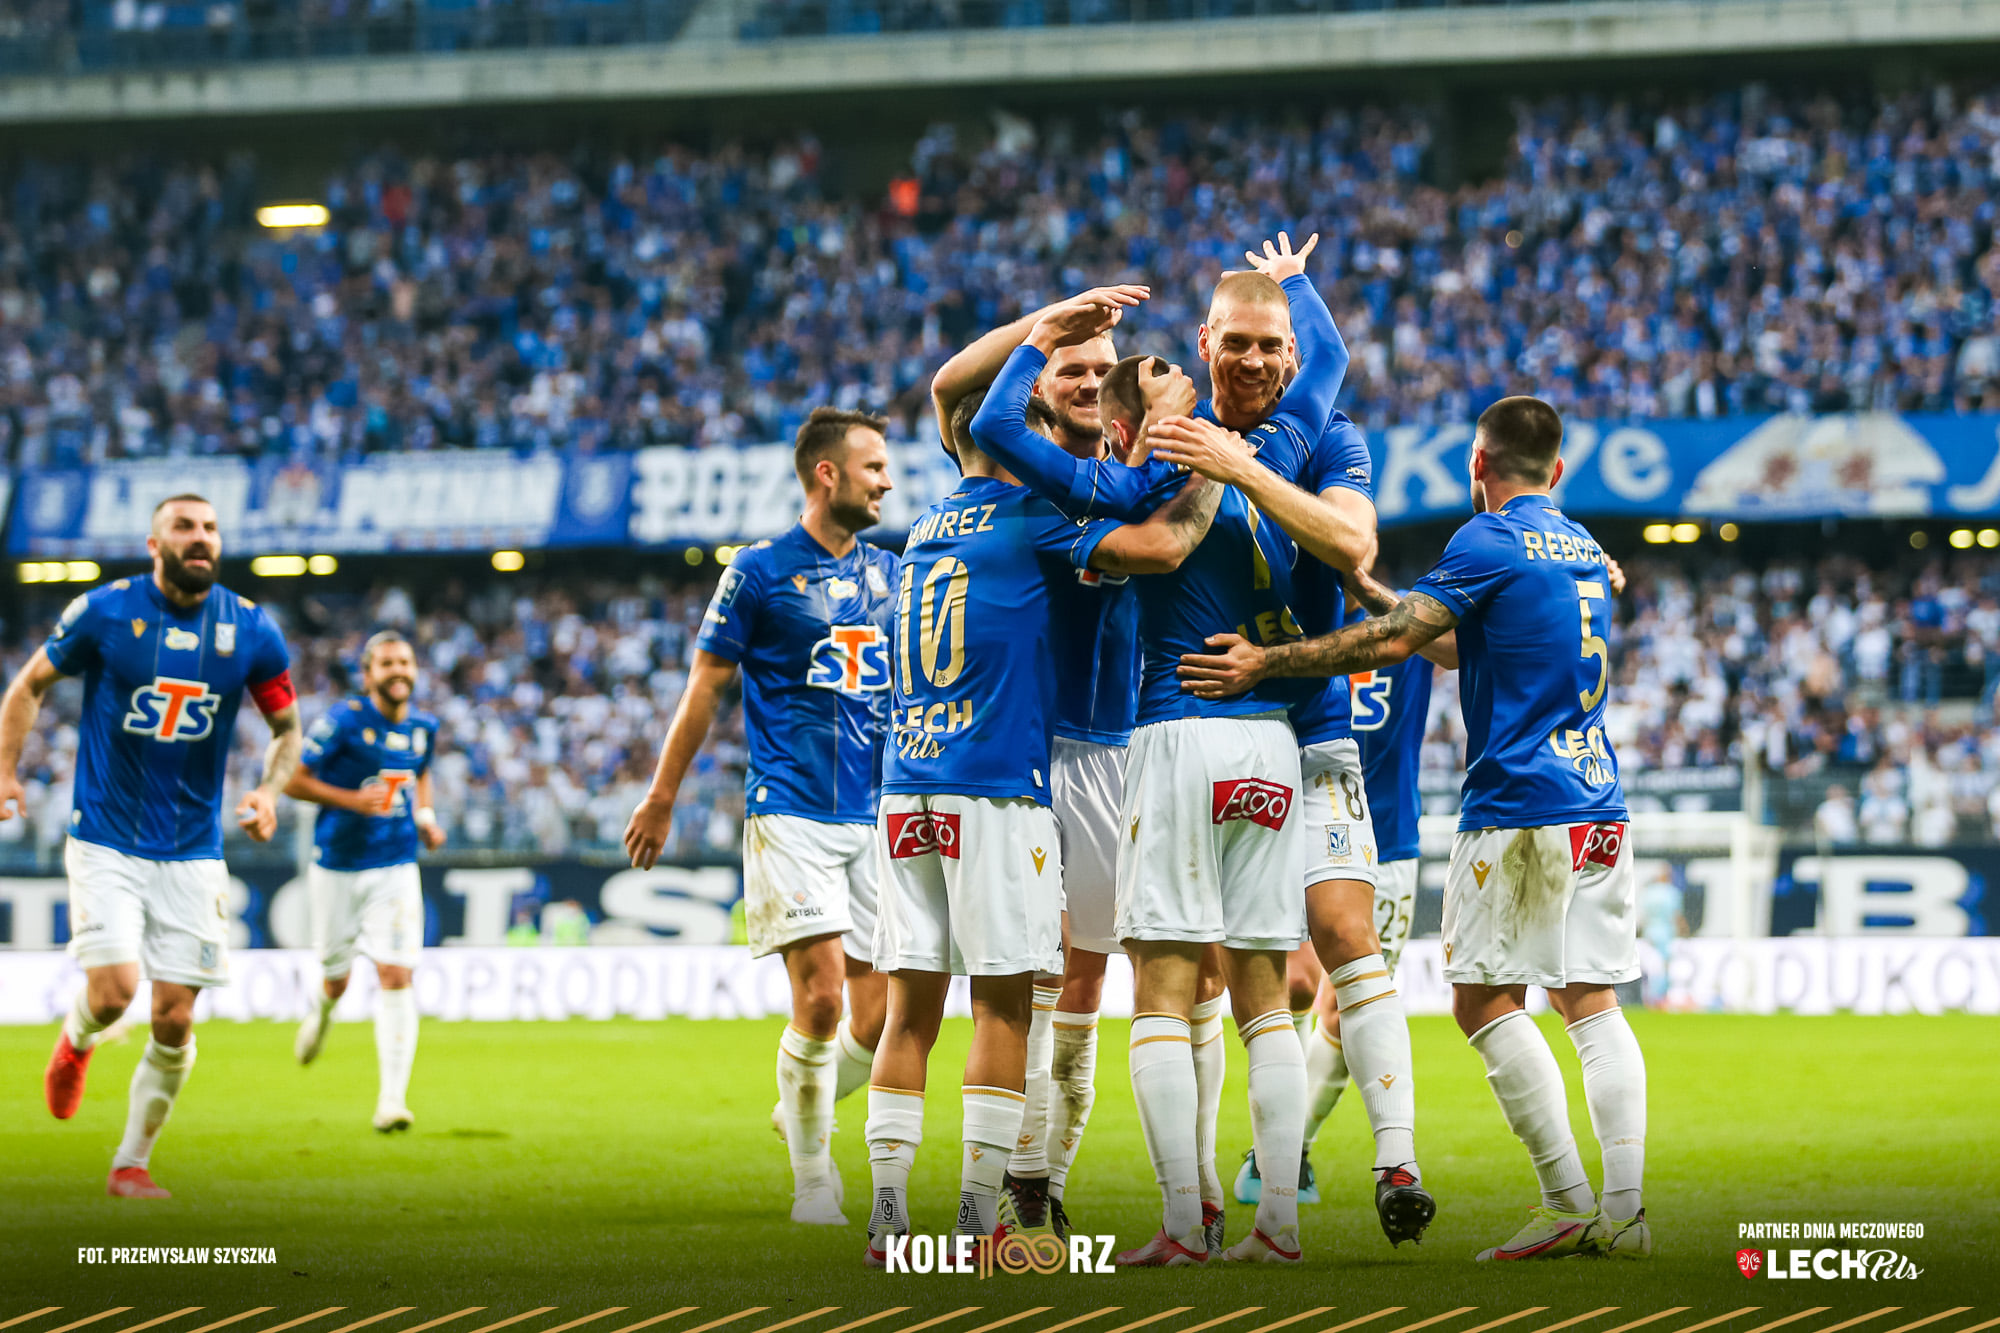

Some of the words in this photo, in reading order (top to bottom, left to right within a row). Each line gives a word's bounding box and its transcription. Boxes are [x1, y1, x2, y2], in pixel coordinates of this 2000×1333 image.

[903, 504, 997, 551] AMIREZ
[807, 625, 892, 694] STS
[895, 556, 968, 695] 10
[1576, 581, 1608, 713] 5
[123, 675, 222, 743] STS
[1314, 770, 1365, 821] 18
[1378, 894, 1411, 942] 25
